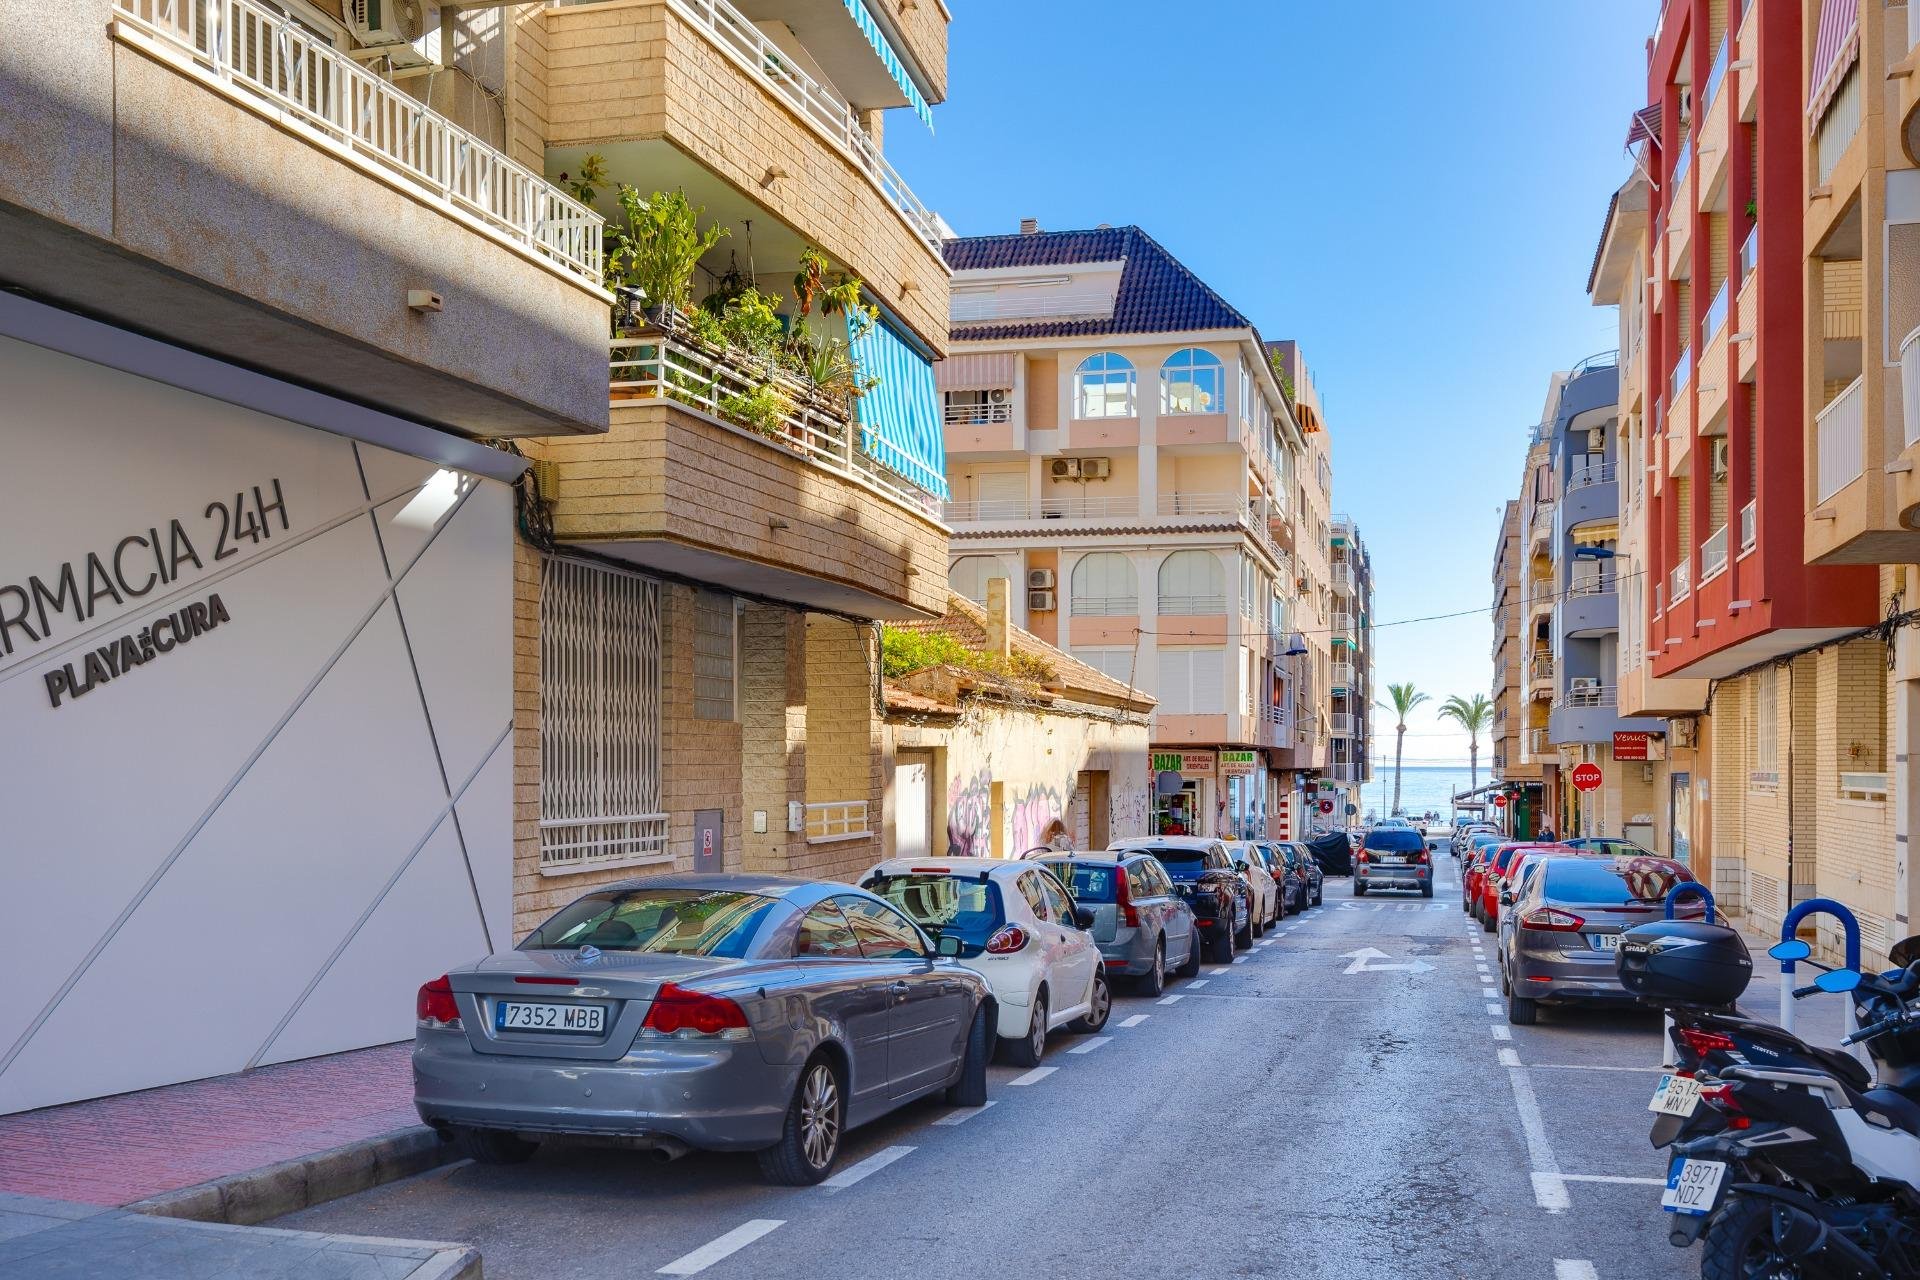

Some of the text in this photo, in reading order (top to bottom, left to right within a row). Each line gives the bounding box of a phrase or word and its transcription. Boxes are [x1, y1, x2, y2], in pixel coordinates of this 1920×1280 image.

[0, 478, 289, 657] RMACIA 24H
[43, 634, 146, 708] PLAYA
[151, 593, 231, 653] CURA
[1615, 733, 1647, 742] Venus
[1153, 753, 1182, 771] BAZAR
[1222, 753, 1253, 762] BAZAR
[1575, 773, 1600, 783] STOP
[1341, 902, 1449, 912] STOP
[1603, 936, 1618, 947] 13
[1625, 945, 1647, 953] SHAD
[509, 1006, 600, 1029] 7352 MBB
[1667, 1079, 1700, 1097] 9514
[1663, 1096, 1690, 1113] MNY
[1681, 1164, 1719, 1186] 3971
[1674, 1185, 1705, 1206] NDZ
